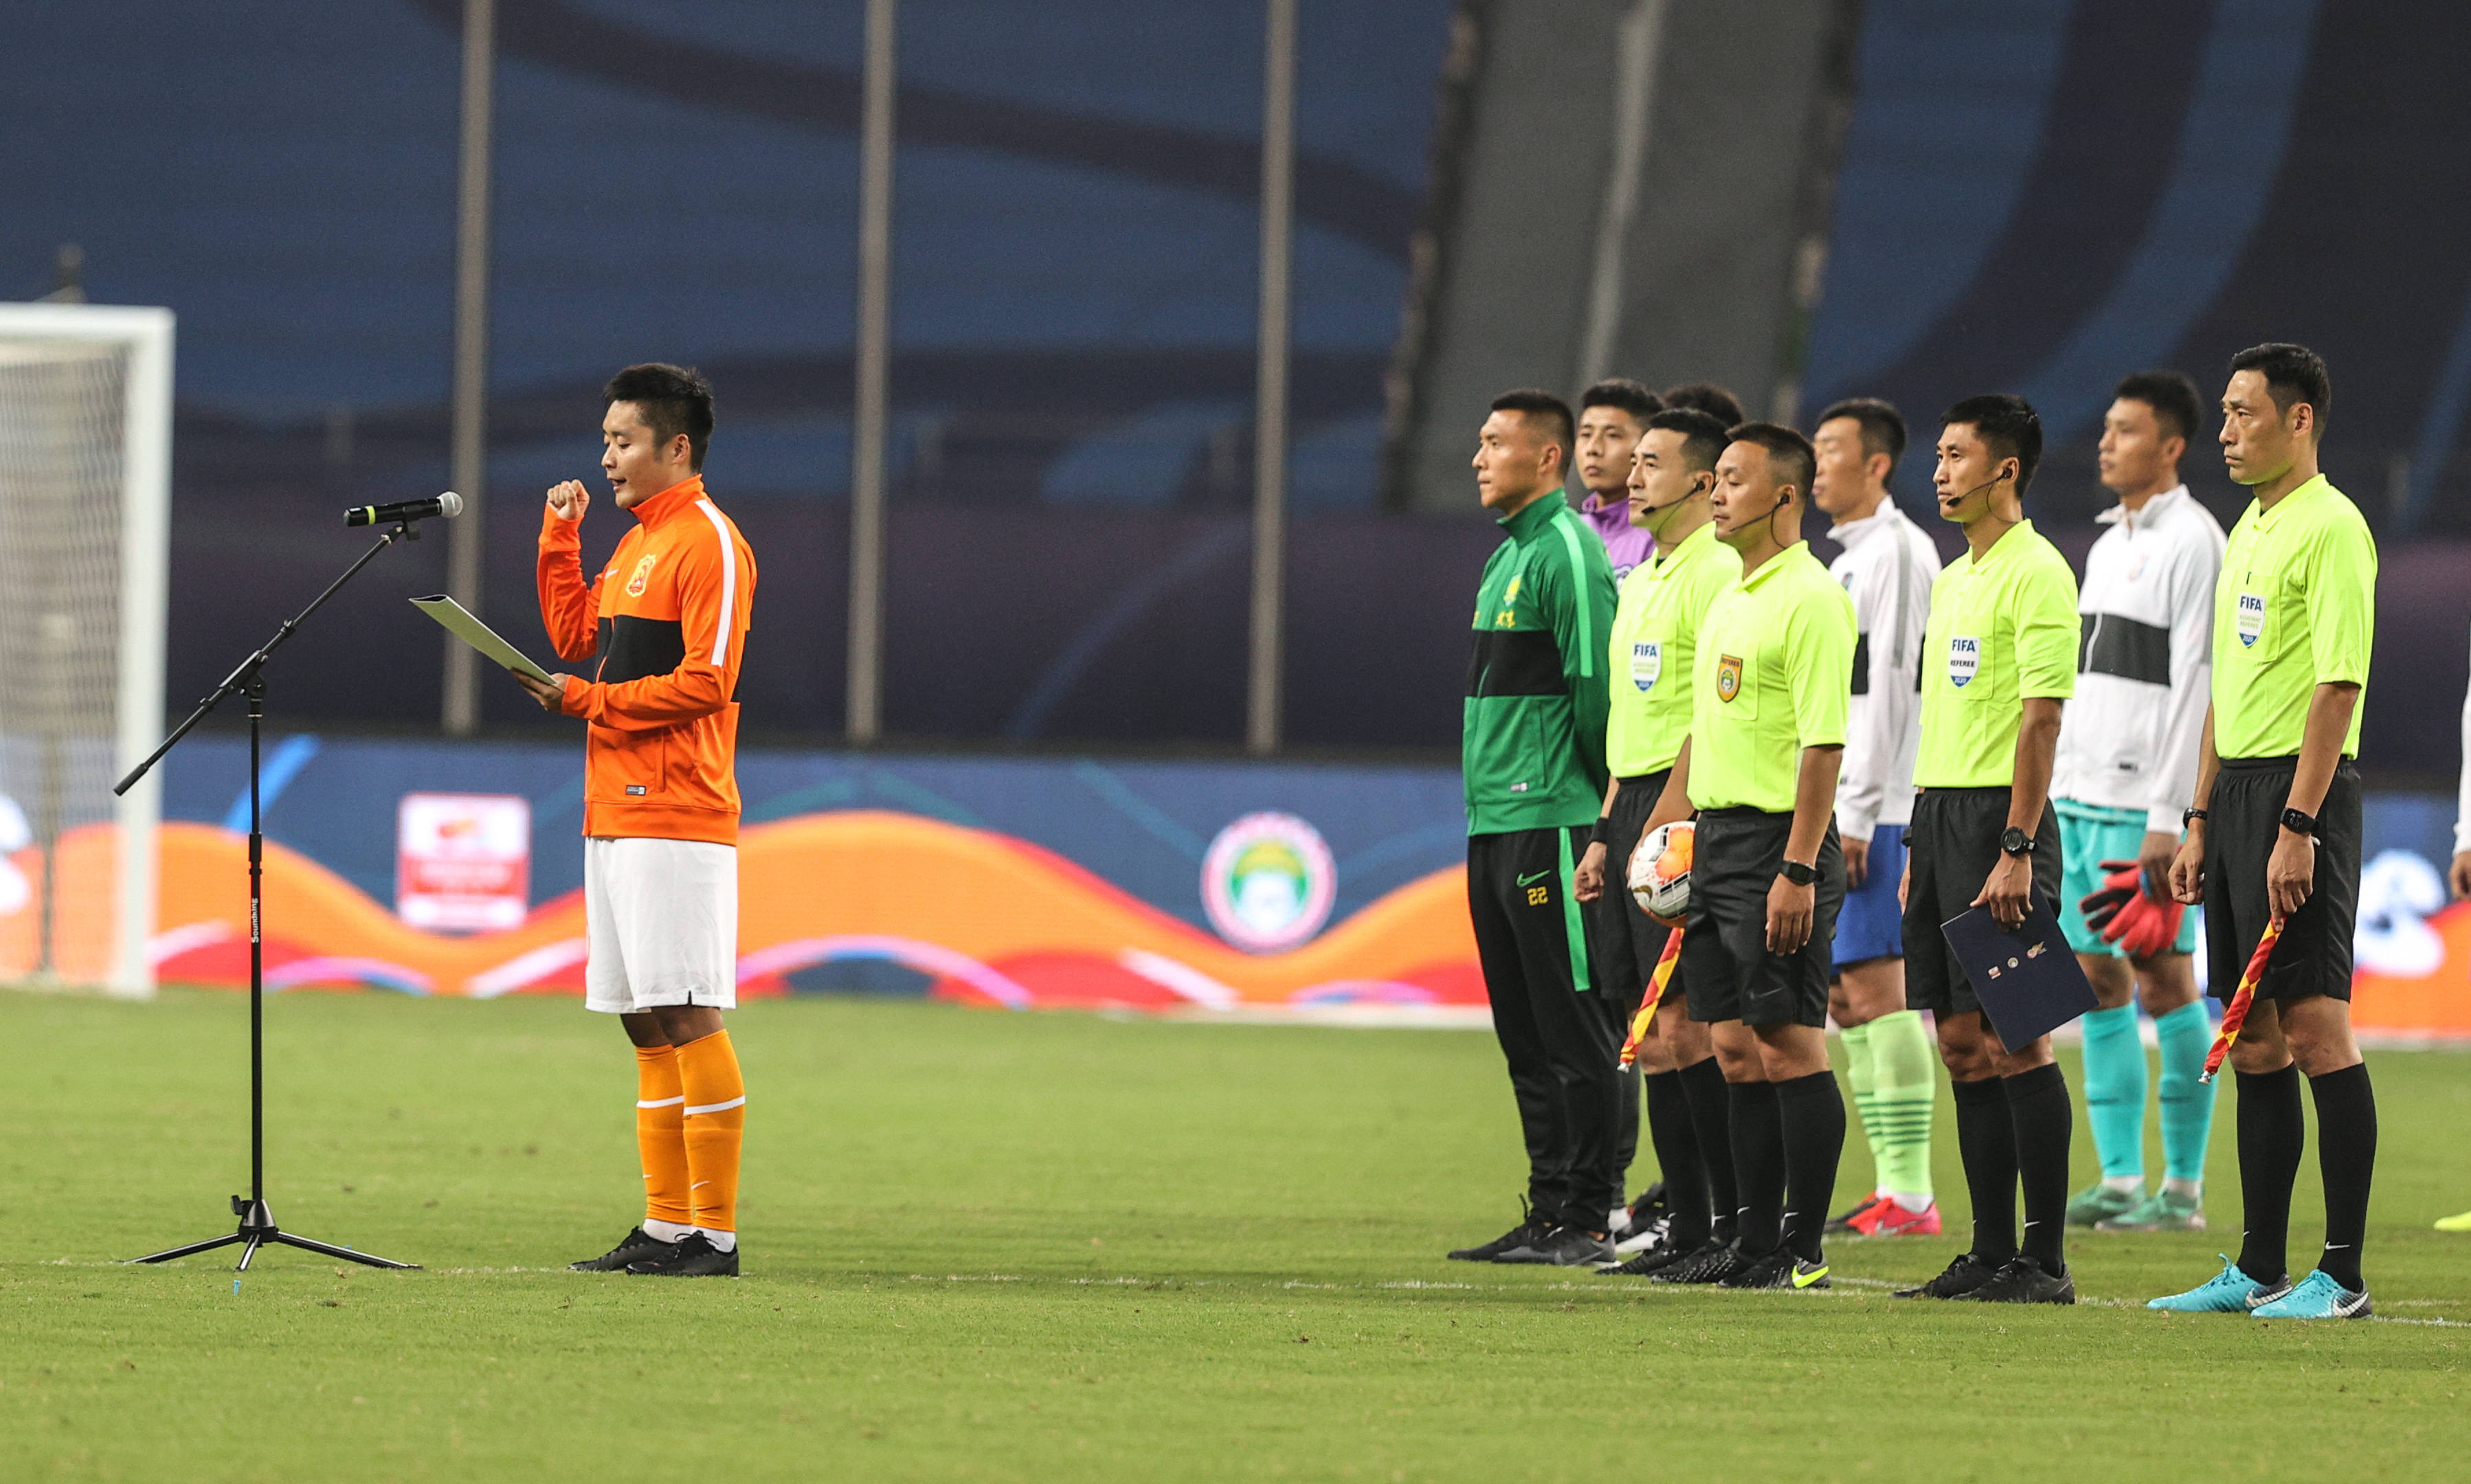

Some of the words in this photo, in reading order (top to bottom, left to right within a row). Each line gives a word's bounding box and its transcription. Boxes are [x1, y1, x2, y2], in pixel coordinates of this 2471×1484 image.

[2240, 595, 2262, 611] FIFA
[1634, 644, 1657, 657] FIFA
[1952, 639, 1976, 652] FIFA
[1950, 660, 1976, 668] REFEREE
